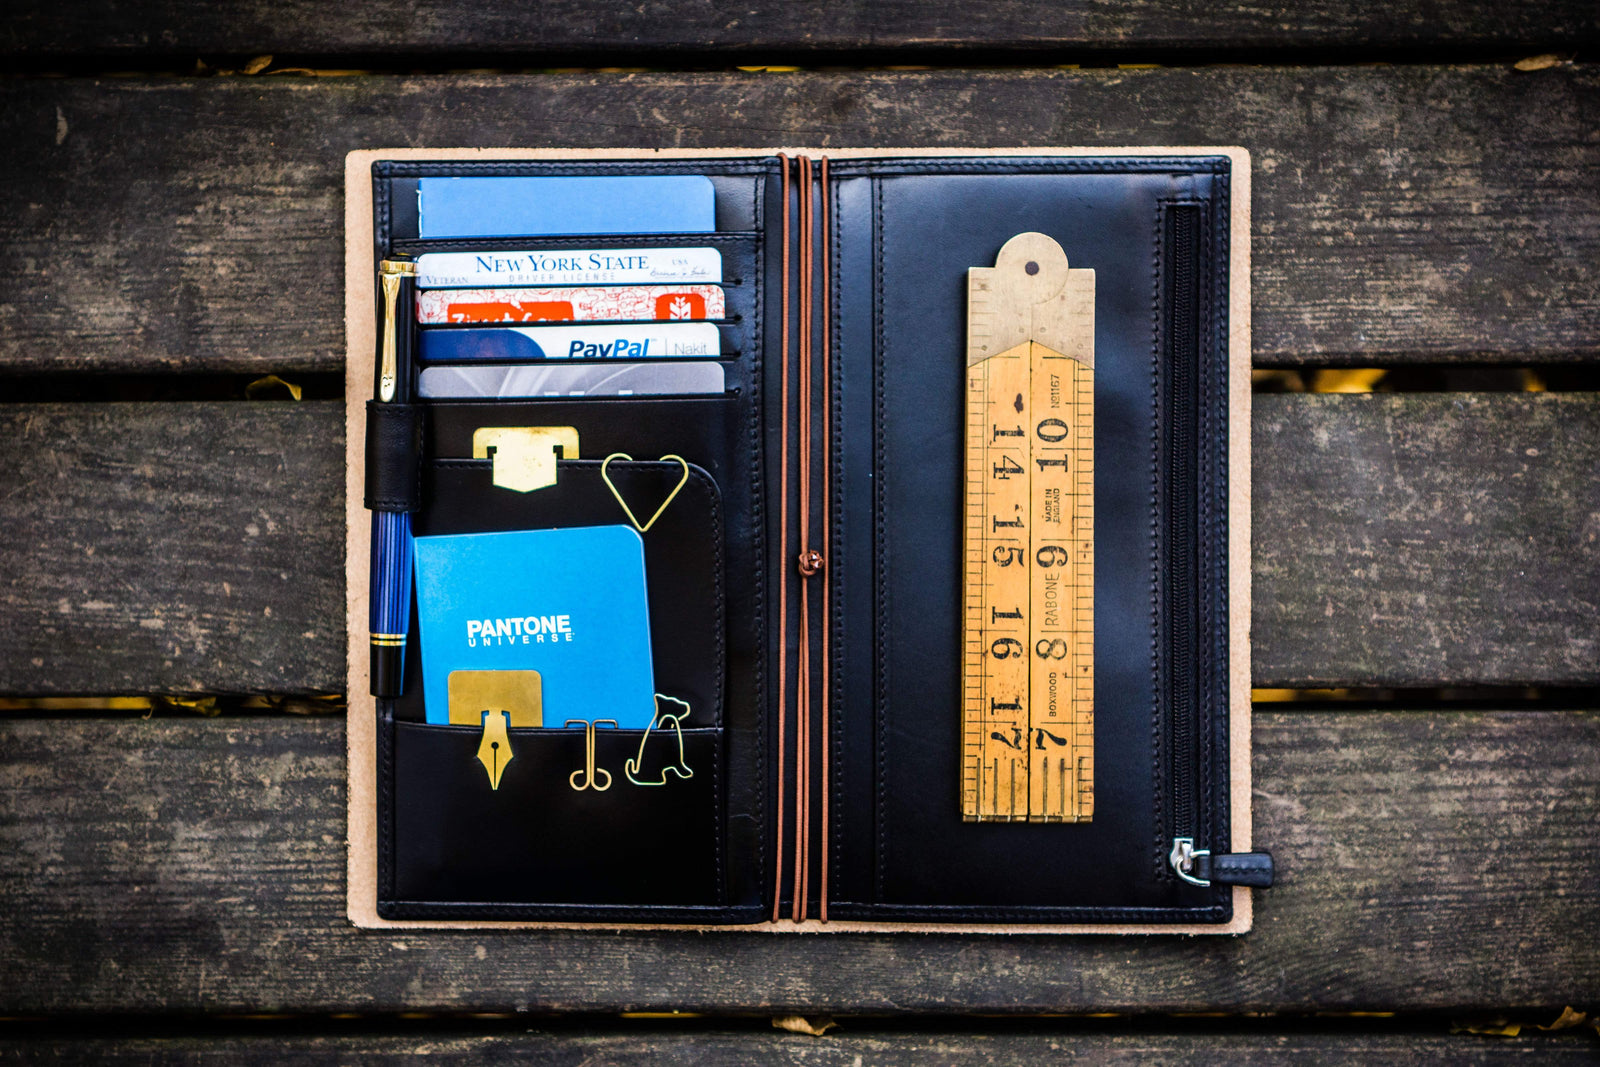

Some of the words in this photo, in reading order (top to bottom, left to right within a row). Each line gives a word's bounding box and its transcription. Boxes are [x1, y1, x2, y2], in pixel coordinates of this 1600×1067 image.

[475, 255, 523, 273] NEW
[527, 254, 583, 272] YORK
[588, 252, 649, 271] STATE
[671, 258, 689, 266] USA
[425, 274, 469, 285] VETERAN
[508, 274, 555, 283] DRIVER
[563, 271, 616, 282] LICENSE
[568, 338, 650, 358] PayPal
[674, 342, 708, 355] Nakit
[1045, 488, 1052, 499] IN
[1045, 572, 1060, 627] RABONE
[466, 614, 573, 638] PANTONE
[468, 632, 574, 648] UNIVERSE
[1035, 638, 1068, 661] 8
[1049, 671, 1057, 718] BOXWOOD
[1035, 727, 1068, 751] 7
